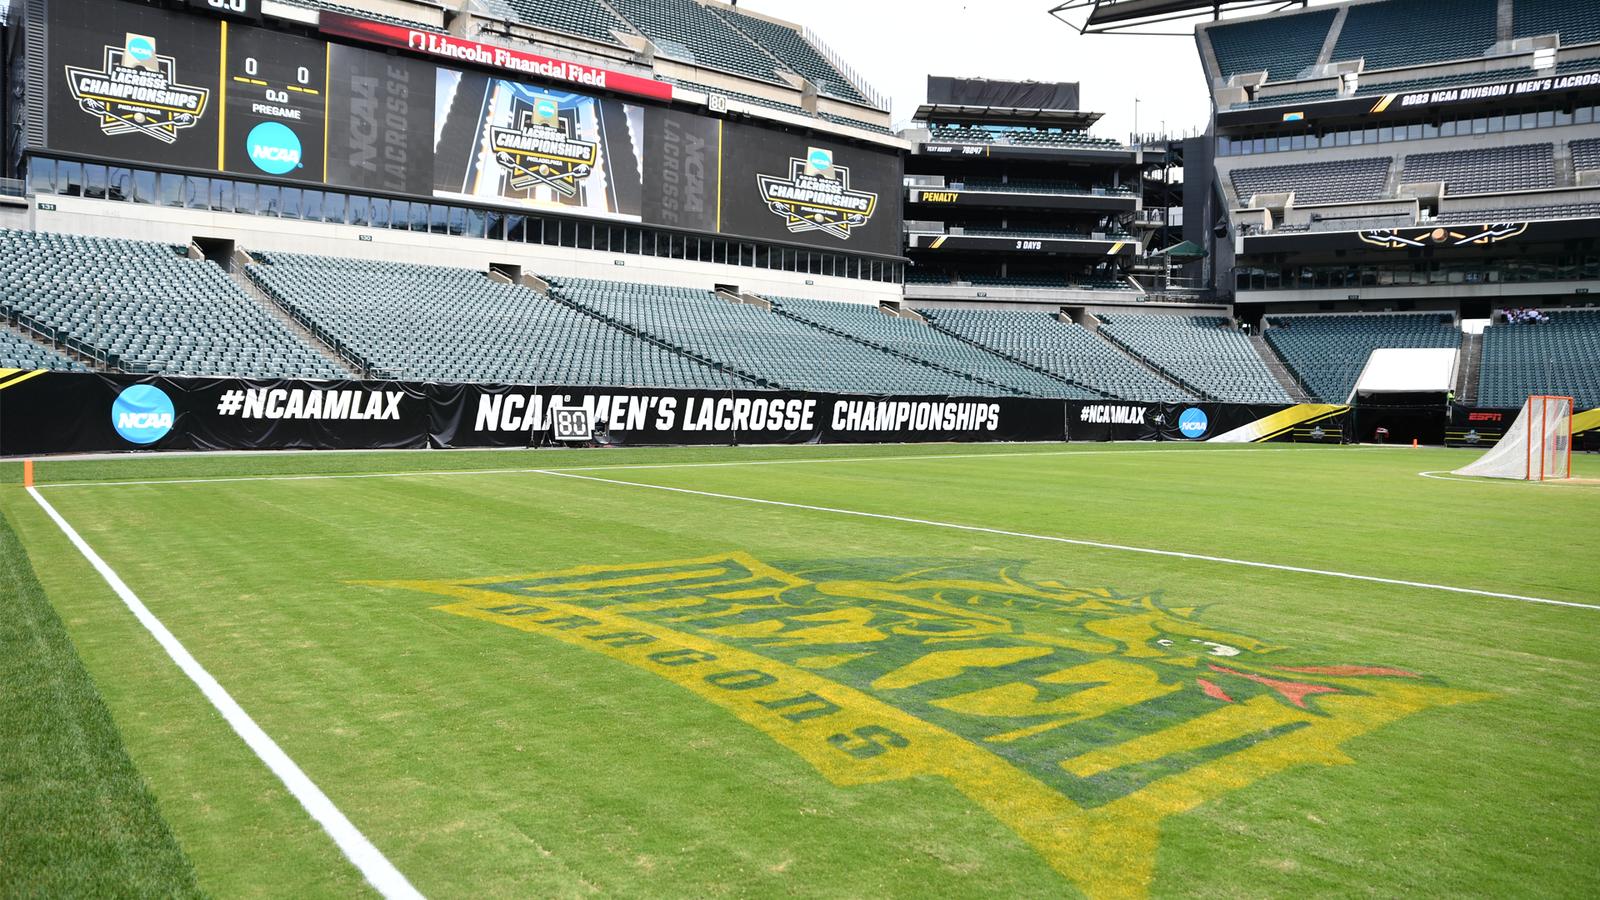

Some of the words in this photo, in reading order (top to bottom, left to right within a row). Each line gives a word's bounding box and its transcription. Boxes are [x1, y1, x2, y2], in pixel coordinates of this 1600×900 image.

[245, 58, 257, 75] 0
[428, 35, 493, 65] Lincoln
[494, 49, 566, 80] Financial
[568, 64, 606, 88] Field
[111, 71, 168, 90] LACROSSE
[297, 67, 309, 84] 0
[80, 78, 197, 109] CHAMPIONSHIPS
[265, 90, 288, 103] 0.0
[1402, 93, 1429, 106] 2023
[1431, 90, 1458, 103] NCAA
[1460, 85, 1507, 100] DIVISION
[1516, 79, 1551, 93] MEN'S
[1553, 73, 1600, 89] LACROS
[118, 104, 161, 115] PHILADELPHIA
[253, 103, 301, 120] PREGAME
[350, 75, 379, 172] NCAA
[384, 65, 409, 191] LACROSSE
[496, 133, 590, 159] CHAMPIONSHIPS
[522, 127, 566, 143] LACROSSE
[253, 144, 299, 164] NCAA
[662, 119, 680, 223] LACROSSE
[684, 133, 704, 212] NCAA
[769, 184, 868, 210] CHAMPIONSHIPS
[795, 179, 843, 195] LACROSSE
[922, 192, 958, 203] PENALTY
[1016, 240, 1022, 249] 3
[1023, 241, 1042, 250] DAYS
[216, 388, 404, 421] #NCAAMLAX
[682, 398, 816, 432] LACROSSE
[831, 400, 1000, 431] CHAMPIONSHIPS
[118, 412, 173, 430] NCAA
[559, 411, 586, 435] 80
[1181, 421, 1207, 431] NCAA
[478, 601, 909, 760] DRAGONS
